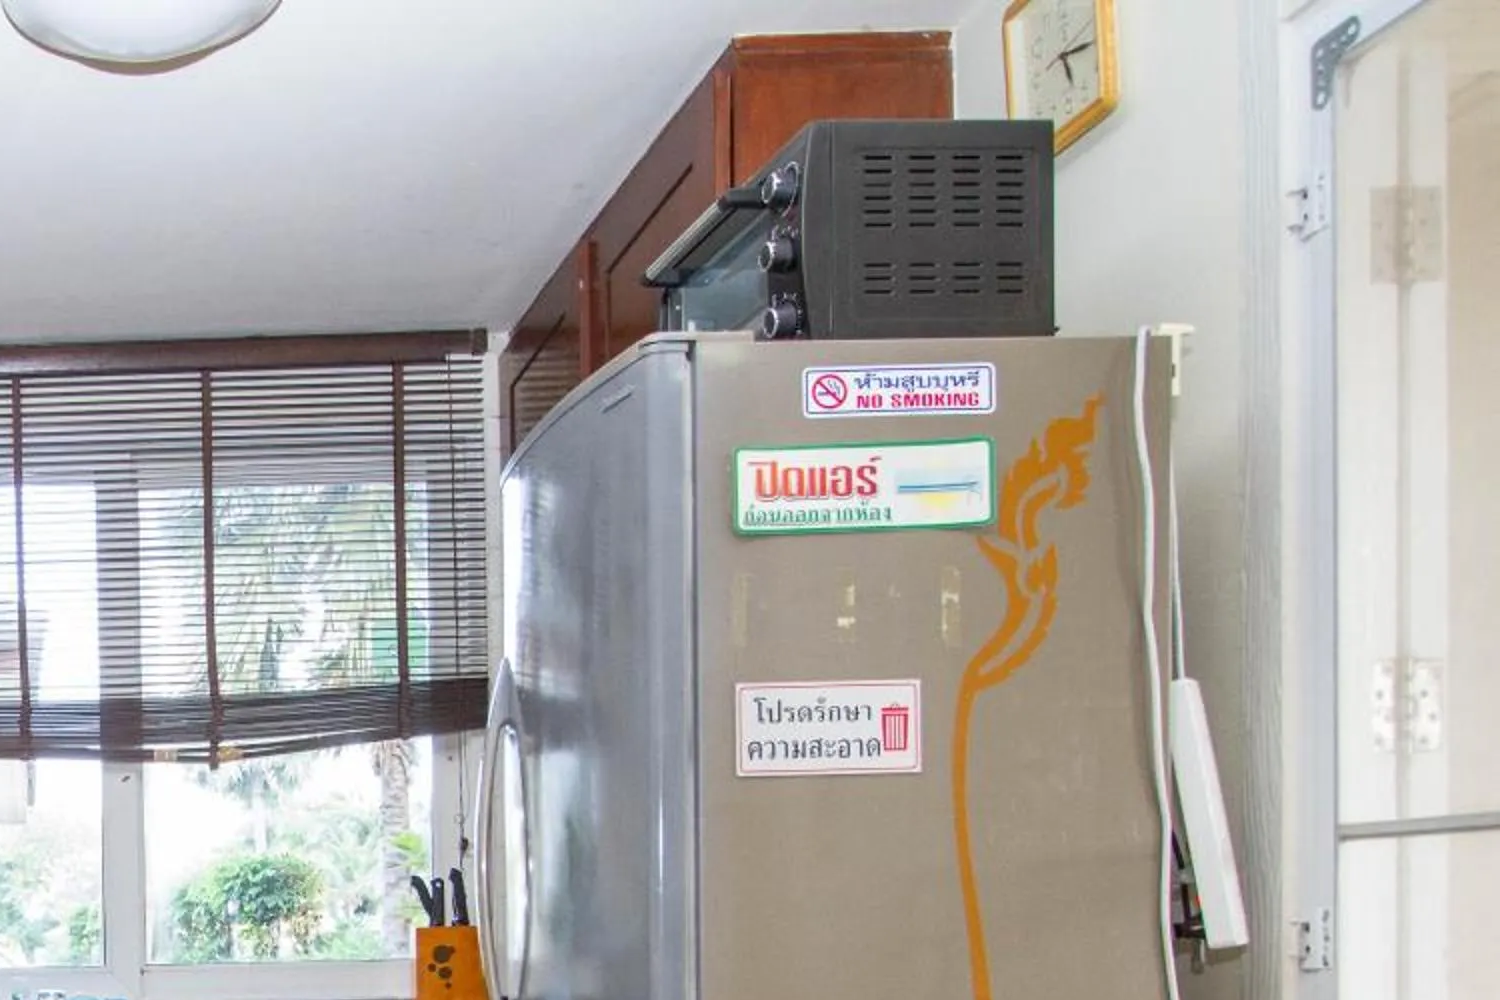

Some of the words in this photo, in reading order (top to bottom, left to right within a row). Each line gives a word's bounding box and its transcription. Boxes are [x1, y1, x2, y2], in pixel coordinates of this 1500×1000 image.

[856, 394, 883, 409] NO
[890, 391, 980, 408] SMOKING
[747, 456, 882, 502] ปิดแอร์
[753, 696, 872, 723] โปรดรักษา
[747, 736, 881, 760] ความสะอาด
